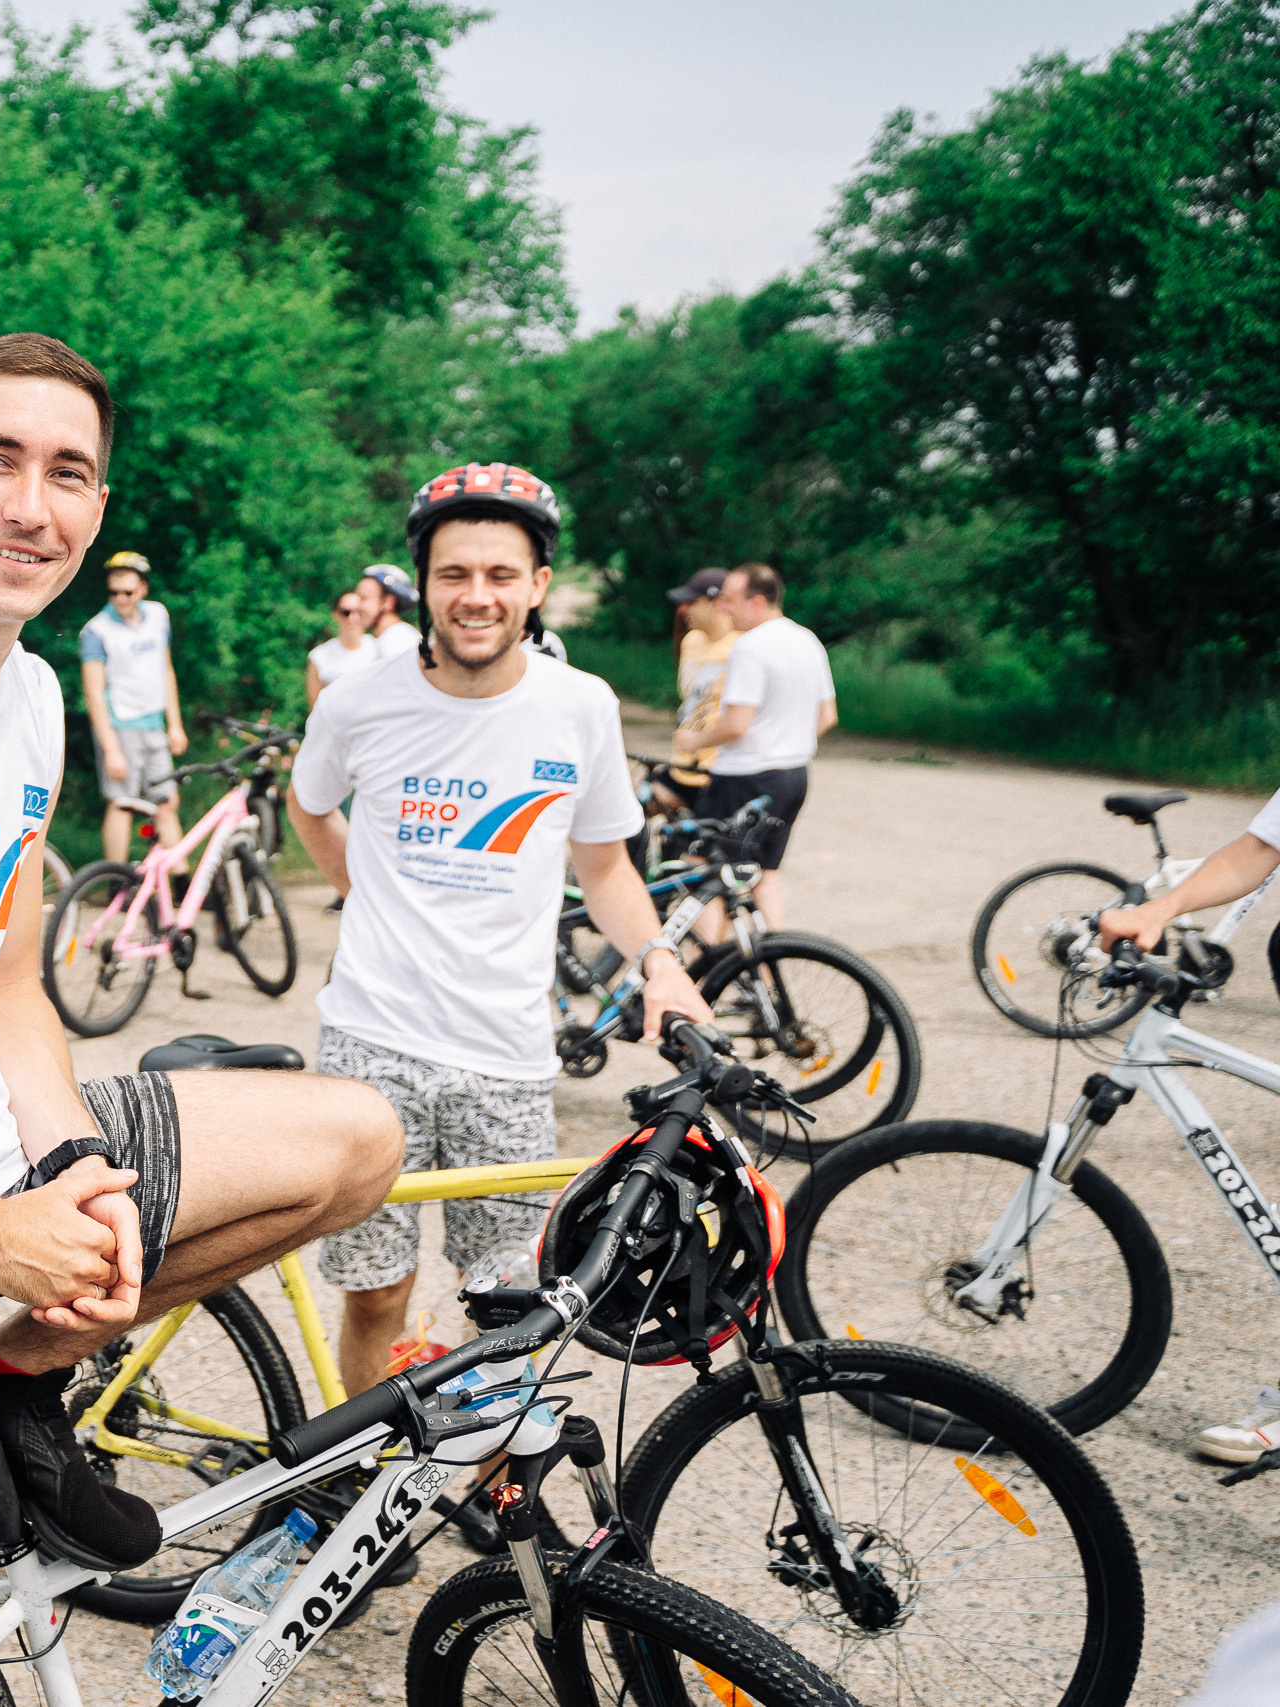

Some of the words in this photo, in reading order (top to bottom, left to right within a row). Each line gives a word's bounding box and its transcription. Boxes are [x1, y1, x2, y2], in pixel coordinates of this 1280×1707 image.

[534, 761, 577, 782] 2022
[401, 800, 459, 822] PRO
[281, 1485, 423, 1653] 203-243
